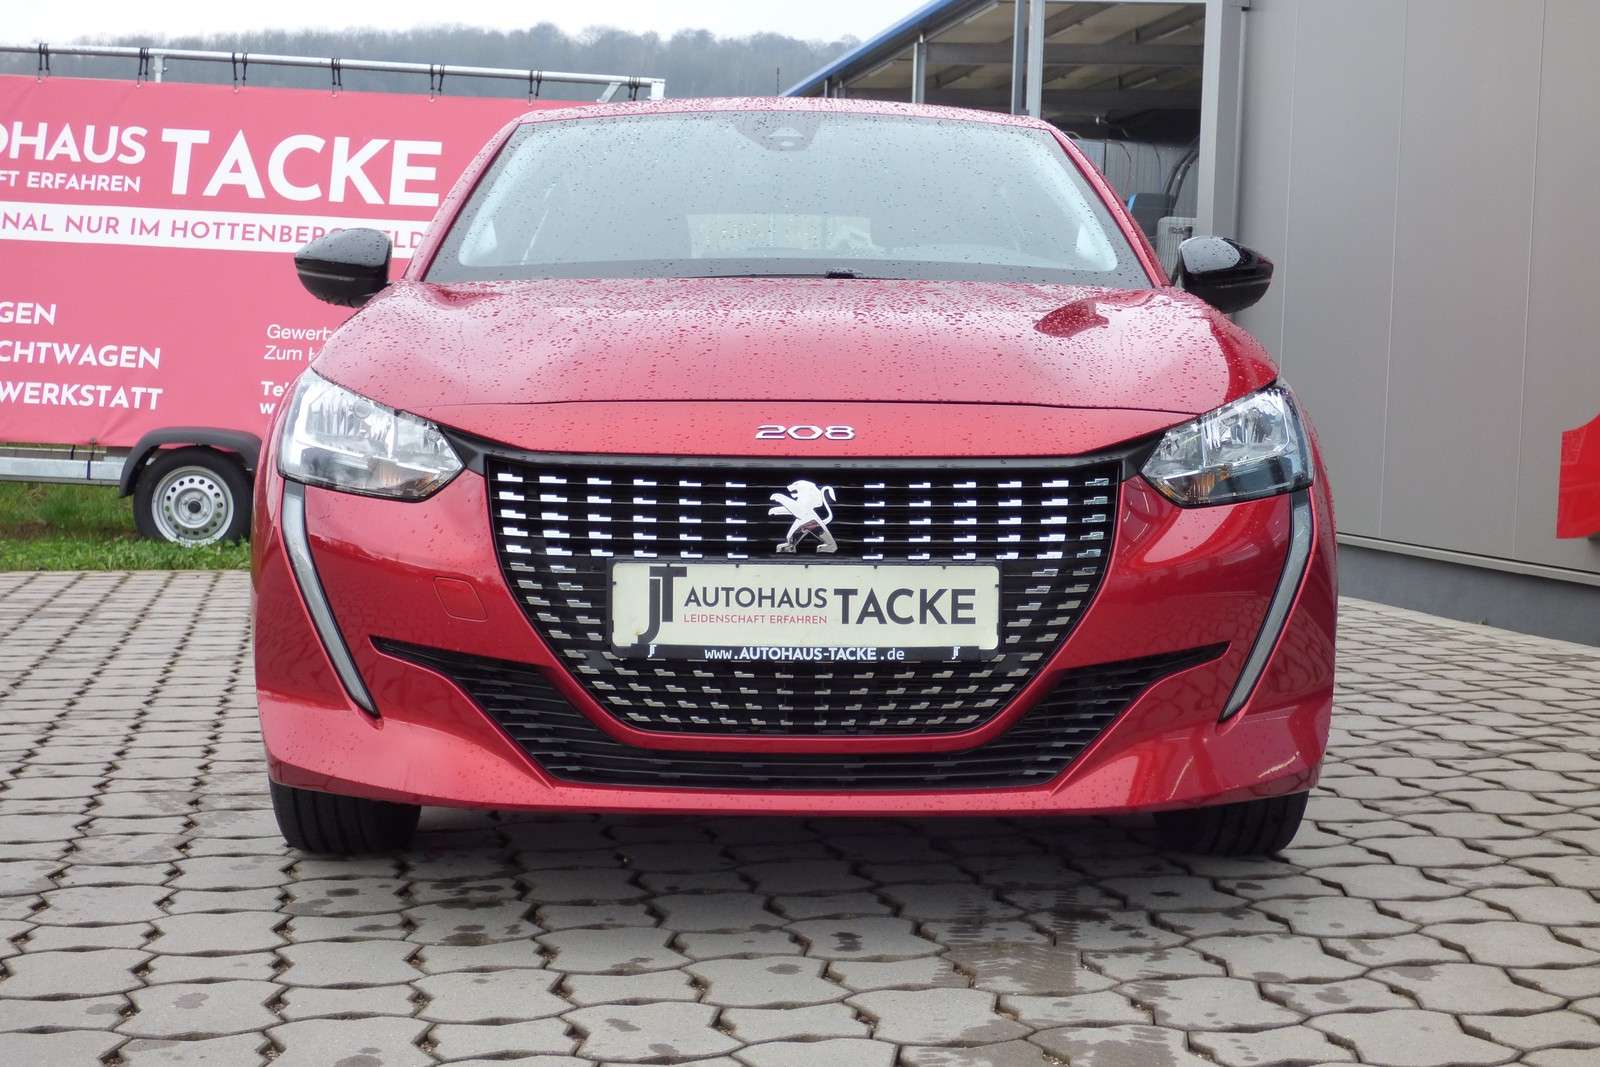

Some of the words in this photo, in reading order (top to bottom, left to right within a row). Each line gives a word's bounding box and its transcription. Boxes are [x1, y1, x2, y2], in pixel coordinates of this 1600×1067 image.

[0, 120, 149, 165] HAUS
[161, 127, 443, 208] TACKE
[27, 171, 141, 193] ERFAHREN
[65, 215, 119, 234] NUR
[130, 217, 160, 237] IM
[263, 345, 303, 361] Zum
[754, 424, 856, 441] 208
[684, 586, 828, 609] AUTOHAUS
[833, 587, 976, 625] TACKE
[683, 613, 765, 625] LEIDENSCHAFT
[769, 615, 828, 626] ERFAHREN
